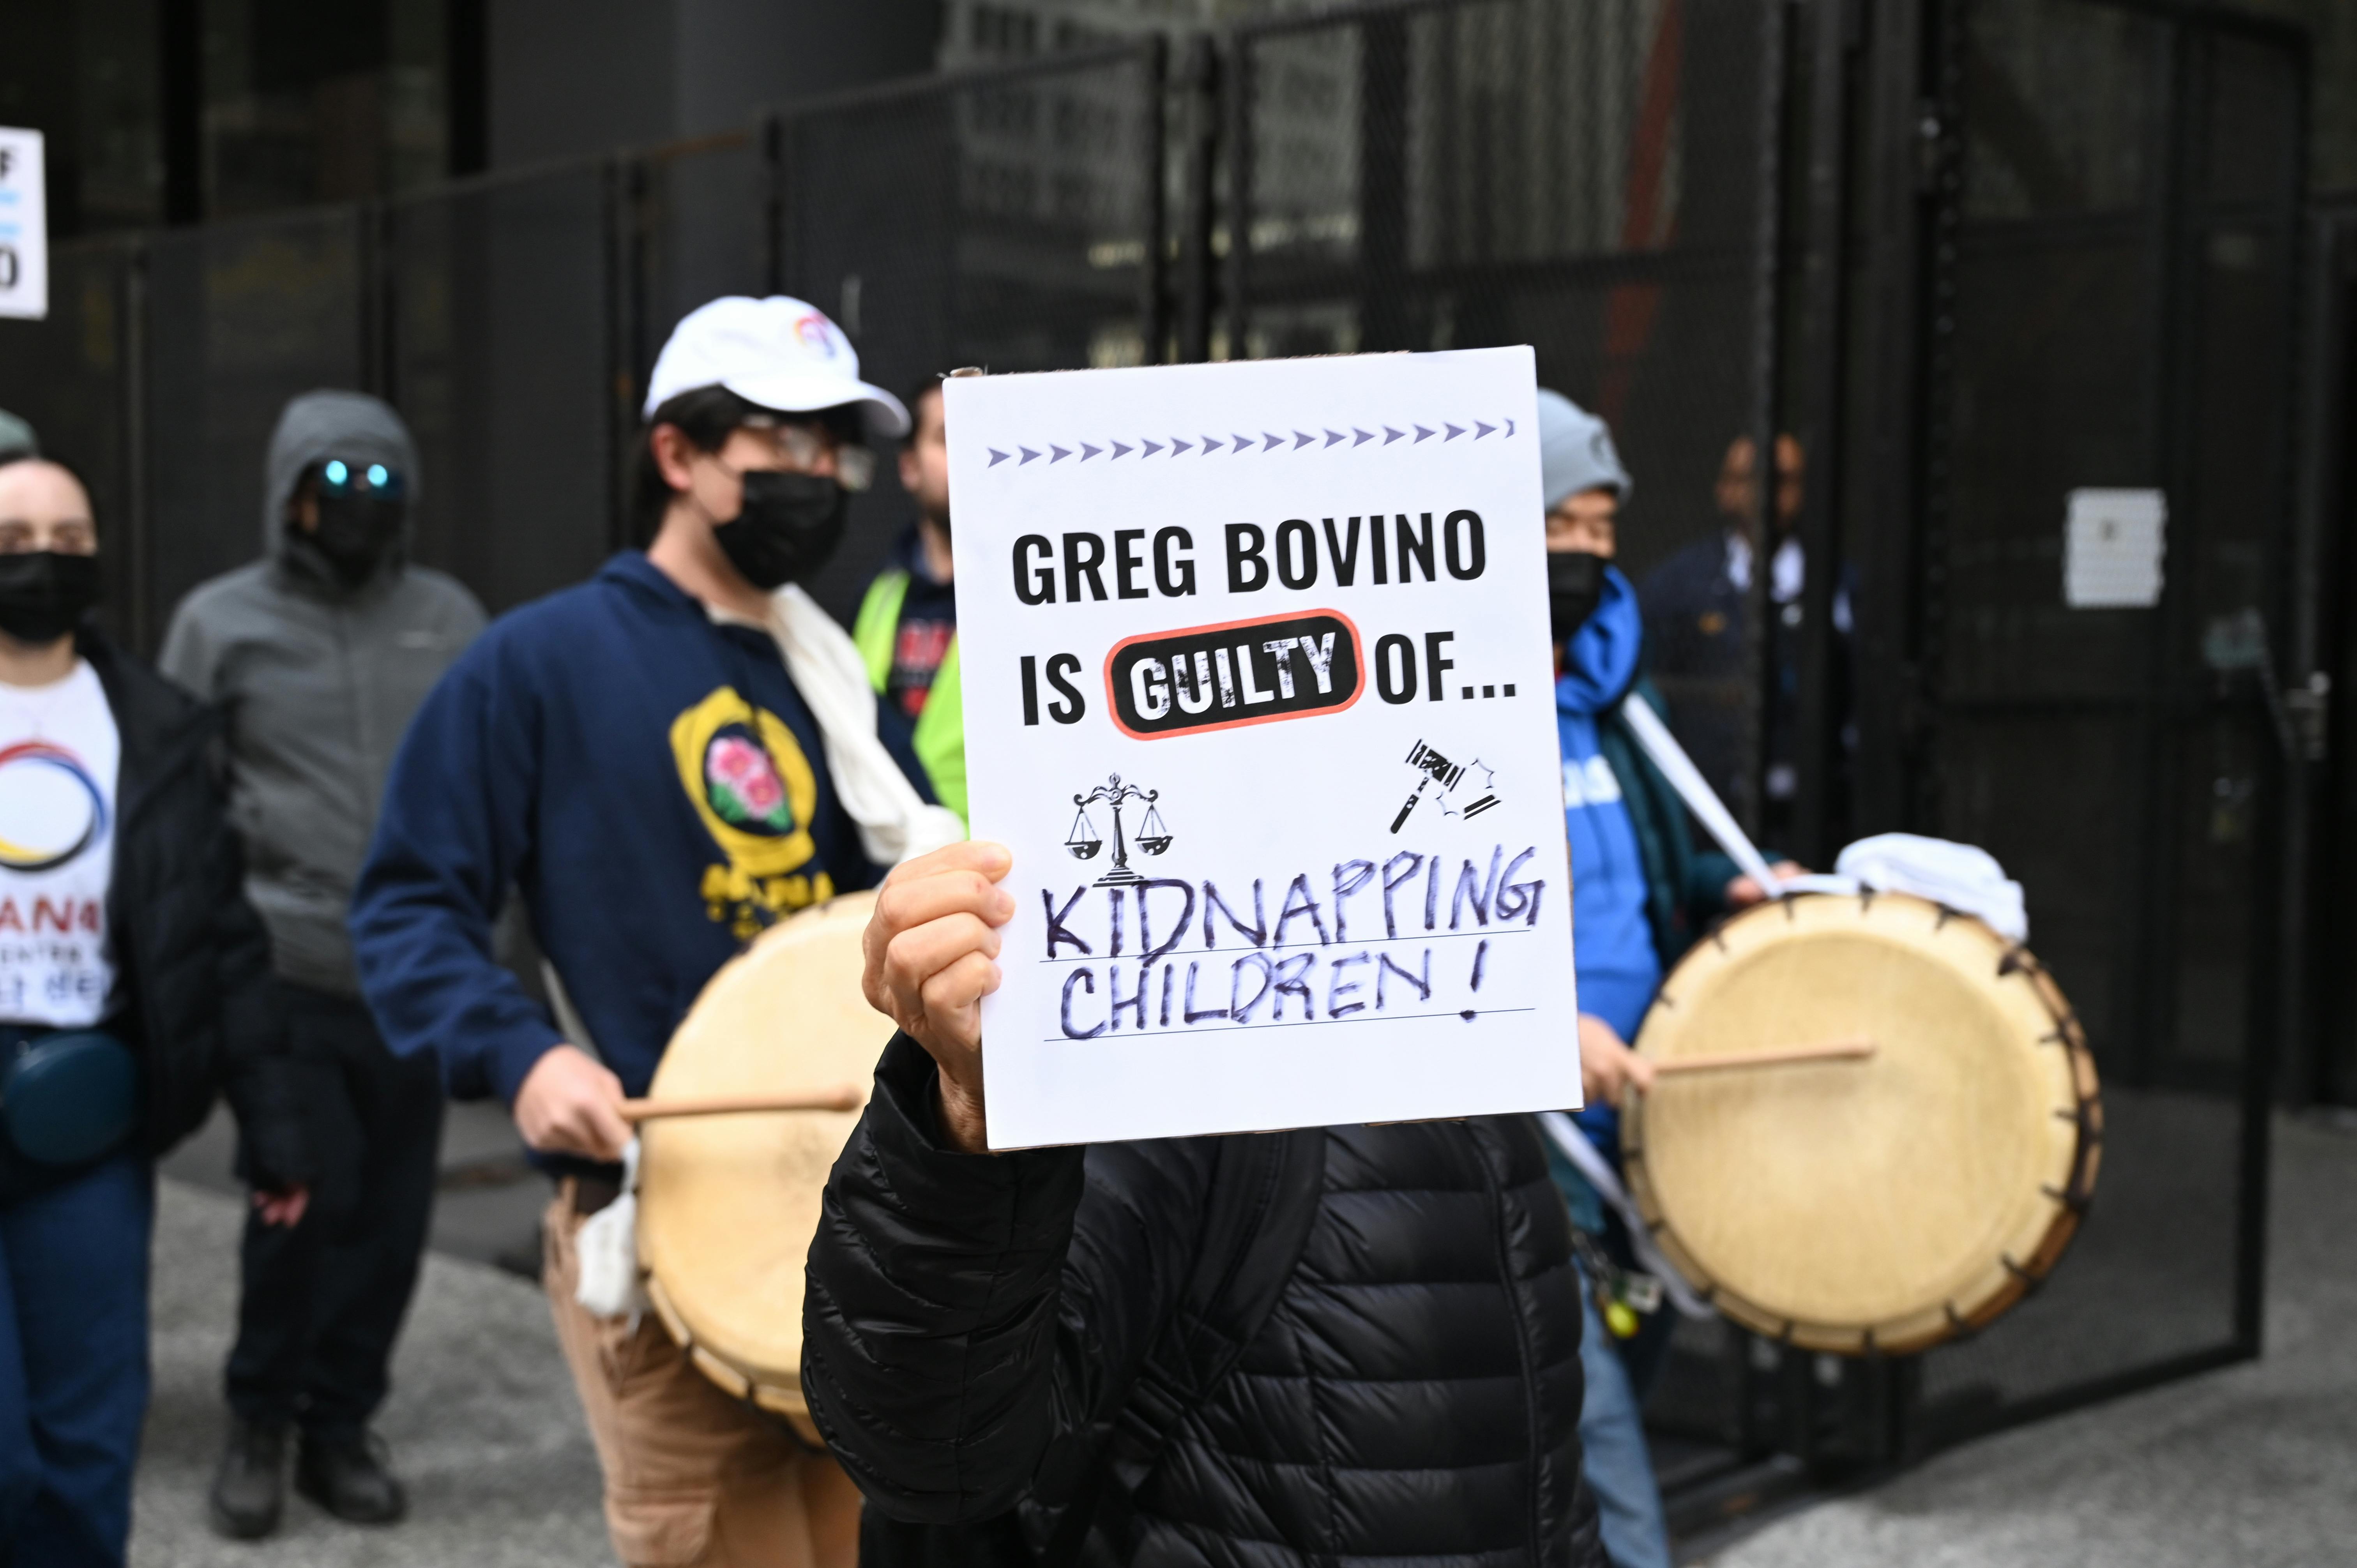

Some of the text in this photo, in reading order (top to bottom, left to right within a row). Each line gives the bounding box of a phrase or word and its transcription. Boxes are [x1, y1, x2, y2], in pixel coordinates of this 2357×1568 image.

[1012, 509, 1486, 606] GREG BOVINO
[1020, 631, 1516, 726] IS GUILTY OF...
[1041, 844, 1545, 967] KIDNAPPING
